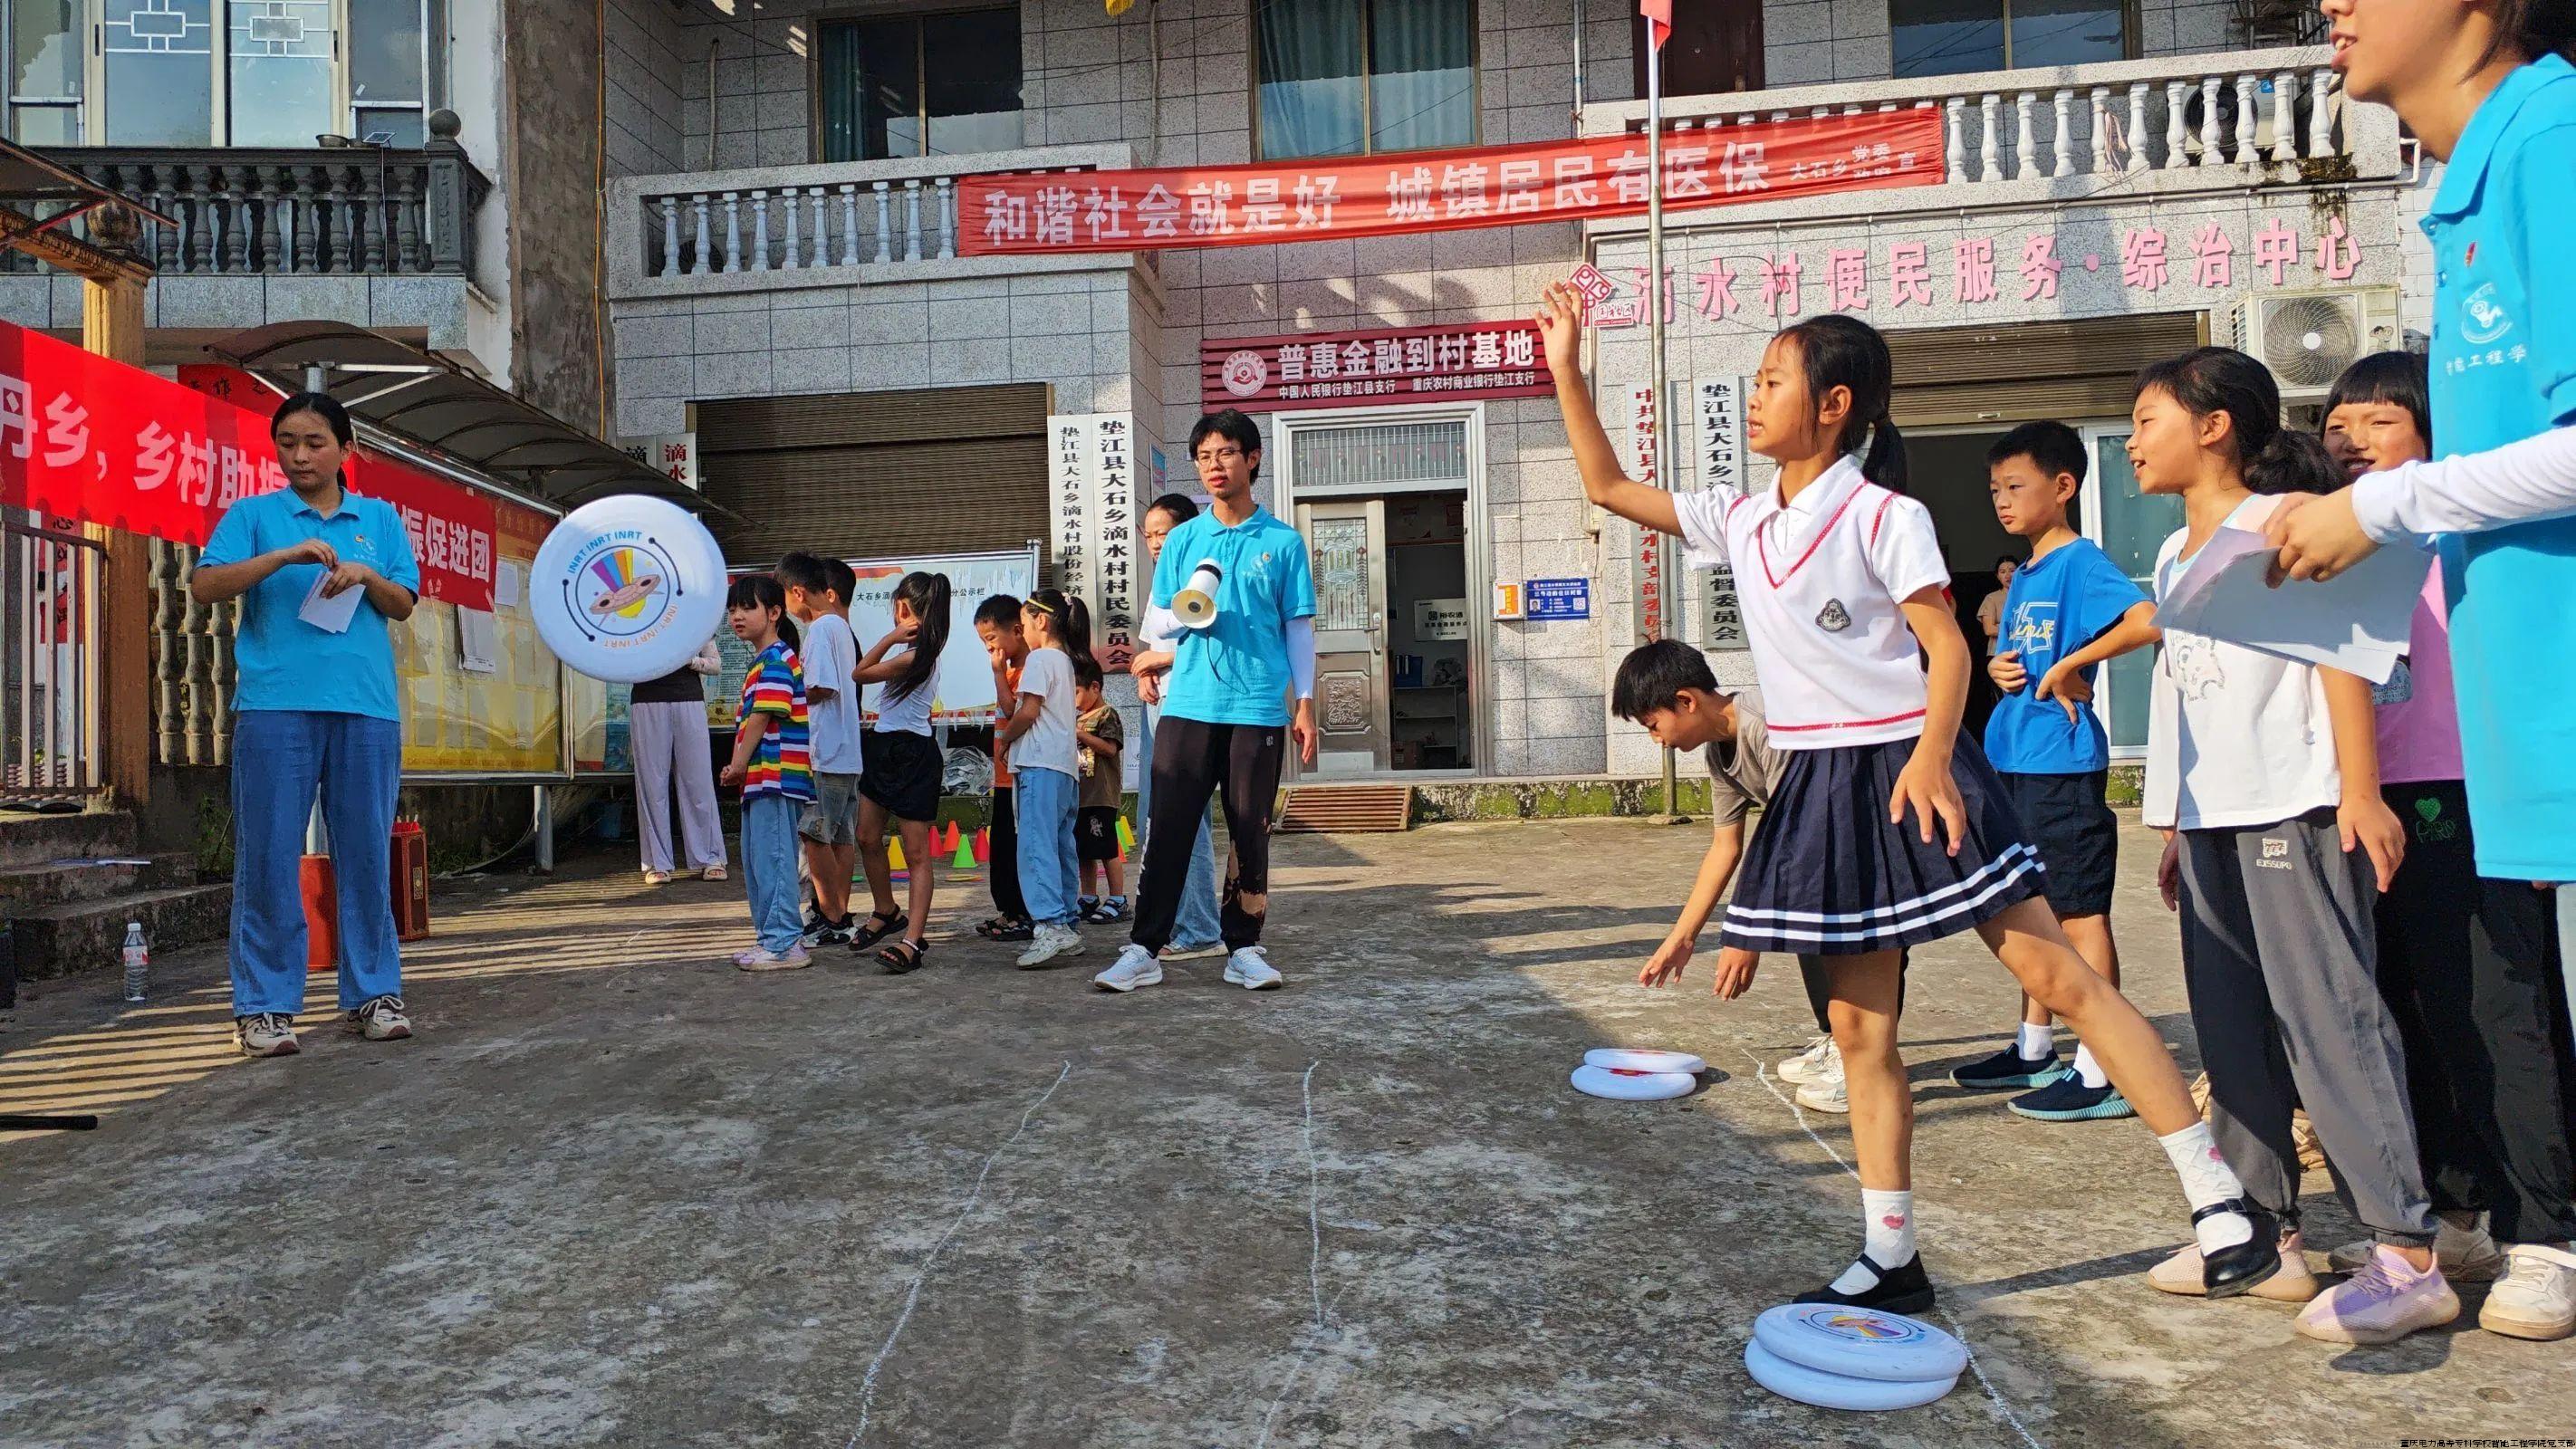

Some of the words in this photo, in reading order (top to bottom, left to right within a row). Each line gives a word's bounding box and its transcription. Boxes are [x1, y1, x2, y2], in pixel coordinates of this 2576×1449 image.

[1789, 157, 1847, 181] 大石乡
[1851, 142, 1890, 163] 党委
[984, 175, 1341, 246] 和谐社会就是好
[1386, 140, 1770, 222] 城镇居民有医保
[1278, 330, 1534, 381] 普惠金融到村基地
[1279, 380, 1396, 399] 中国人民银行垫江县支行
[1412, 372, 1535, 392] 重庆农村商业银行垫江支行
[568, 549, 590, 574] INRT
[586, 533, 611, 552] INRT
[615, 531, 642, 541] INRT
[1099, 420, 1132, 665] 垫江县大石乡滴水村村民委员会
